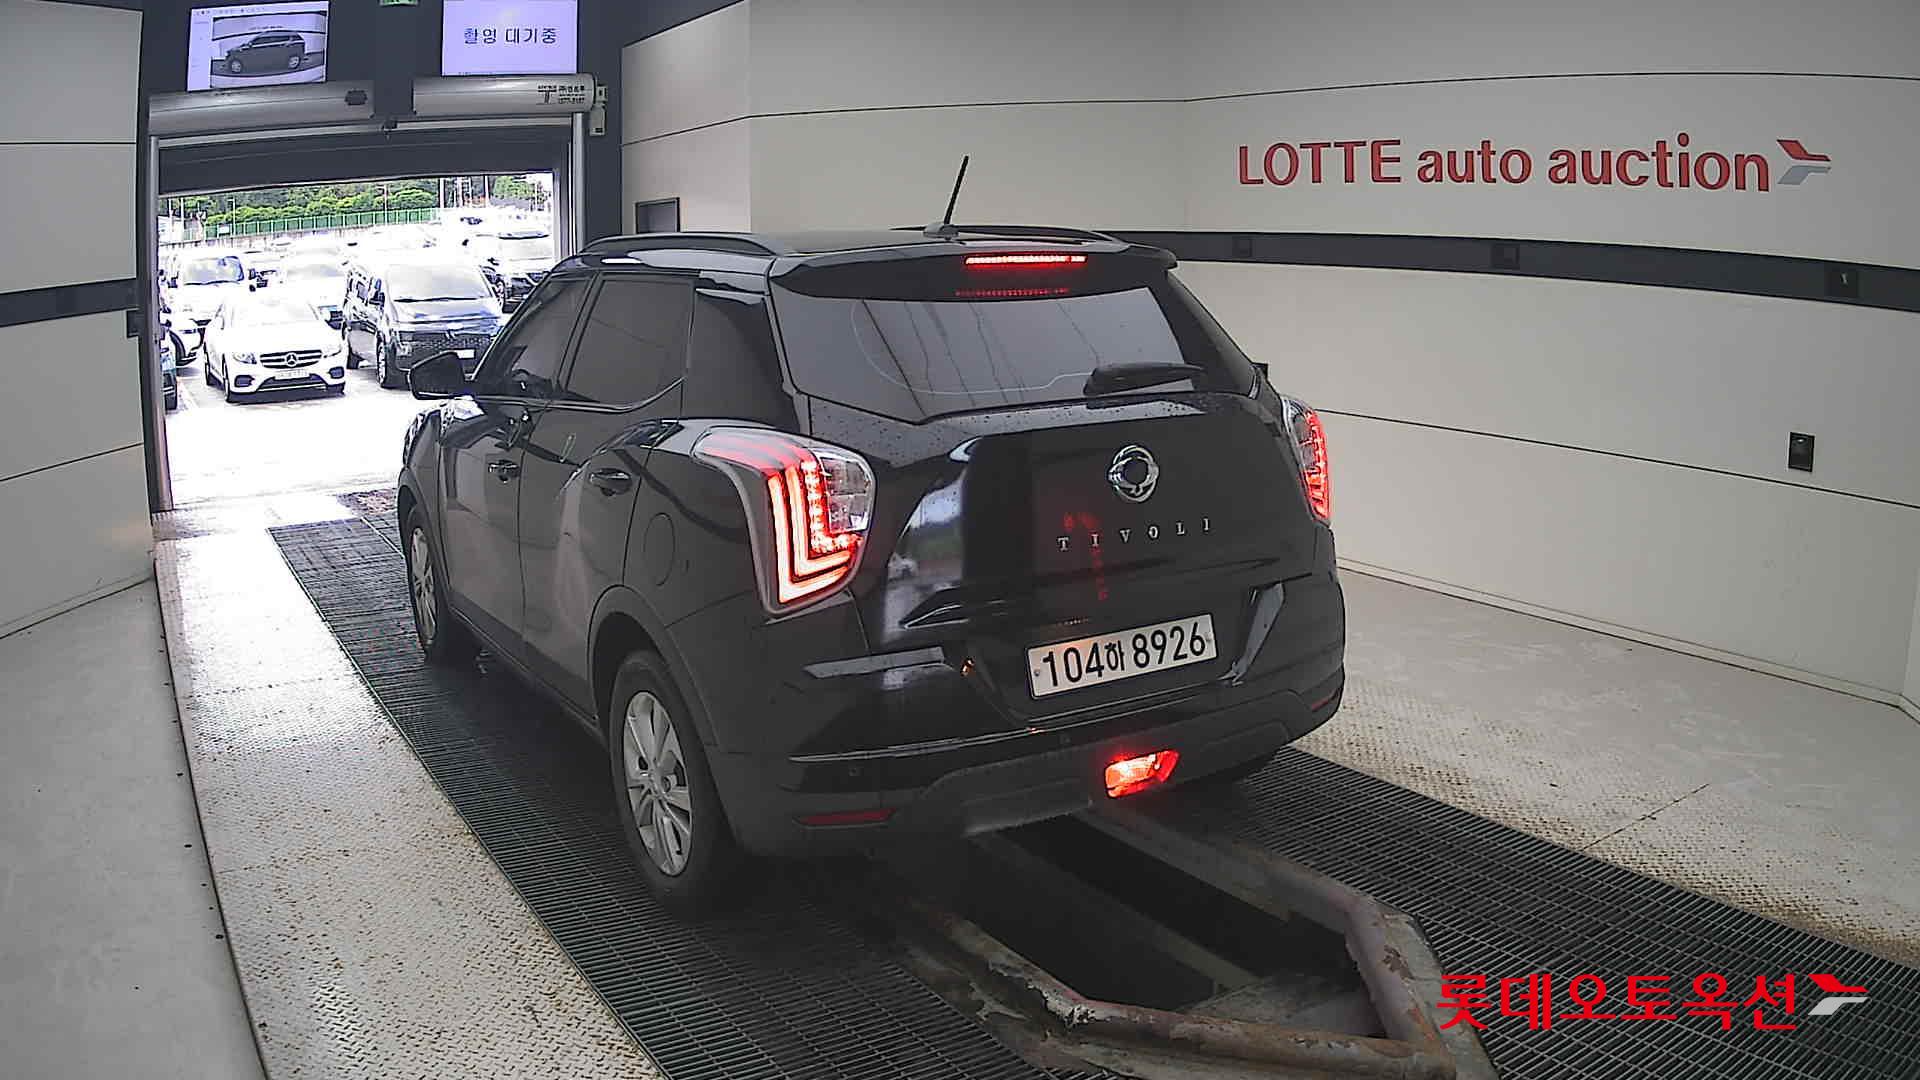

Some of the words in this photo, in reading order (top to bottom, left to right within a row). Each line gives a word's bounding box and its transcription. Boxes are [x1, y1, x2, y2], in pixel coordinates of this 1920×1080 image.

[505, 27, 557, 44] 대기중
[1239, 139, 1401, 186] LOTTE
[1416, 139, 1532, 184] auto
[1548, 132, 1770, 192] auction
[1057, 517, 1210, 552] TIVOLI
[1042, 639, 1126, 687] 104하
[1131, 621, 1206, 669] 8926
